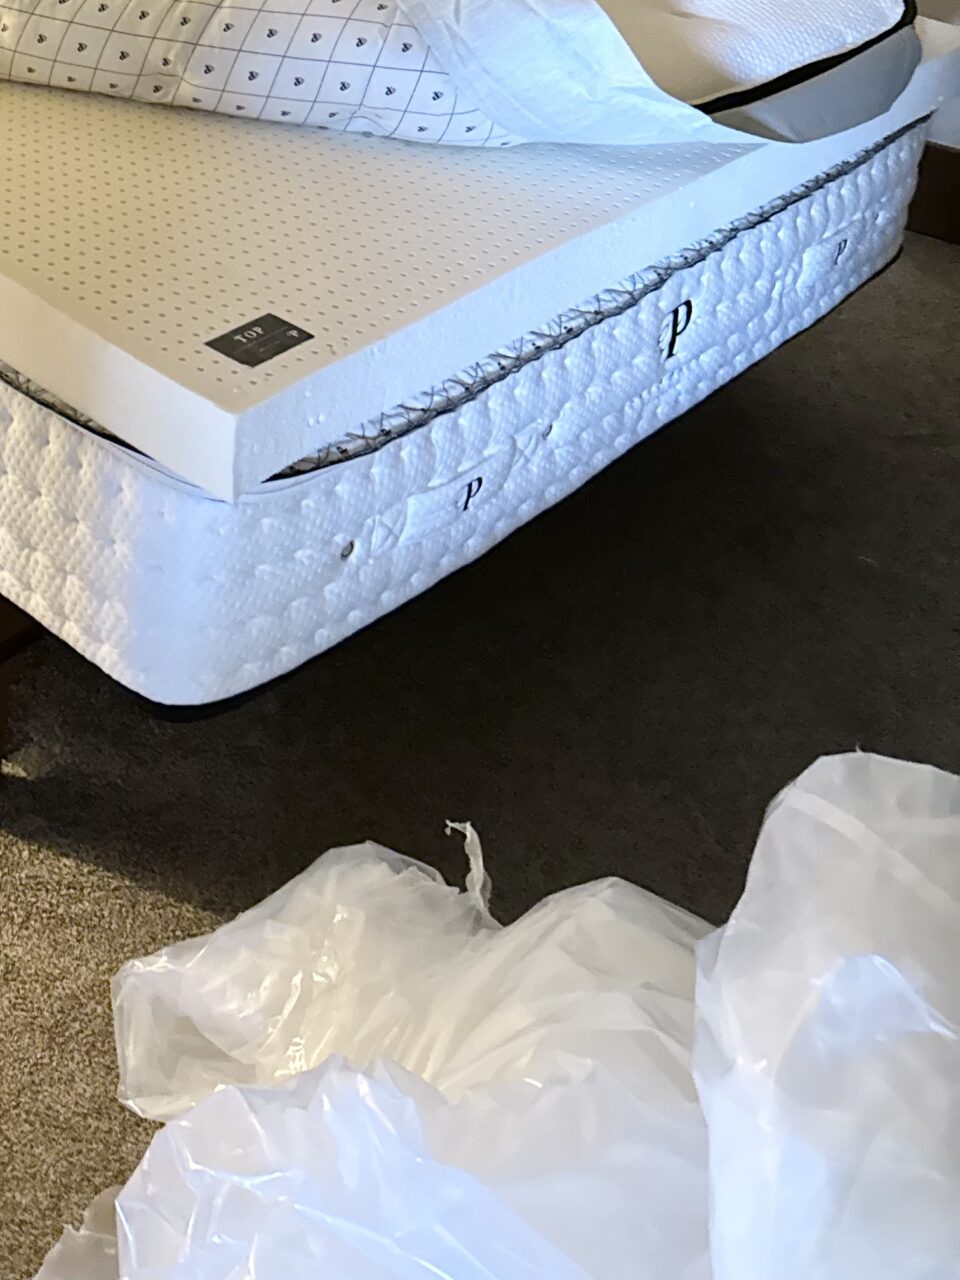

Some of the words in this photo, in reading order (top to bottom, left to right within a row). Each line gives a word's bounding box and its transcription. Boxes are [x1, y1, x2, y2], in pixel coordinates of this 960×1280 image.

[233, 326, 264, 343] TOP
[658, 299, 692, 360] P
[455, 476, 483, 512] P
